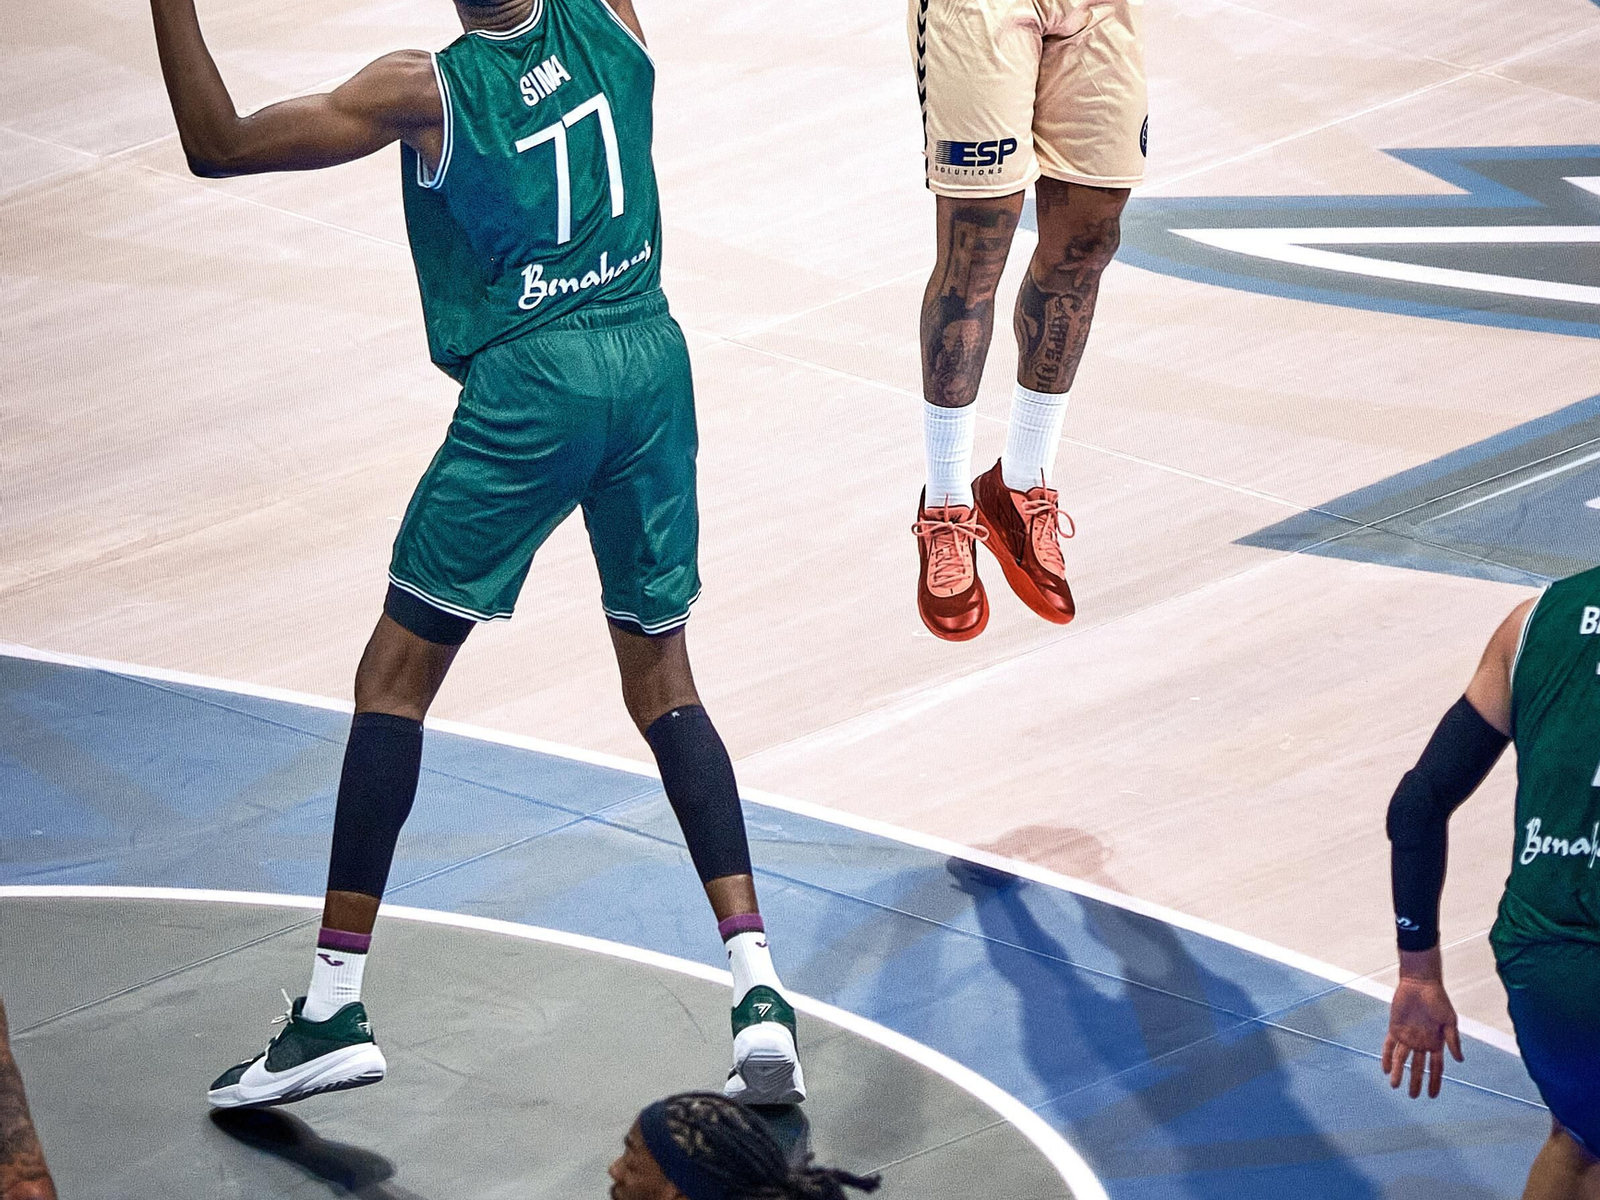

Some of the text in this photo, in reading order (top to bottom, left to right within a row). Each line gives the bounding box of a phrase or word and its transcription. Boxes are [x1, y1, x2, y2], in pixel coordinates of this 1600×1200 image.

[950, 138, 1017, 167] ESP
[515, 92, 624, 245] 77
[935, 165, 1002, 176] SOLUTIONS
[1579, 605, 1600, 635] B
